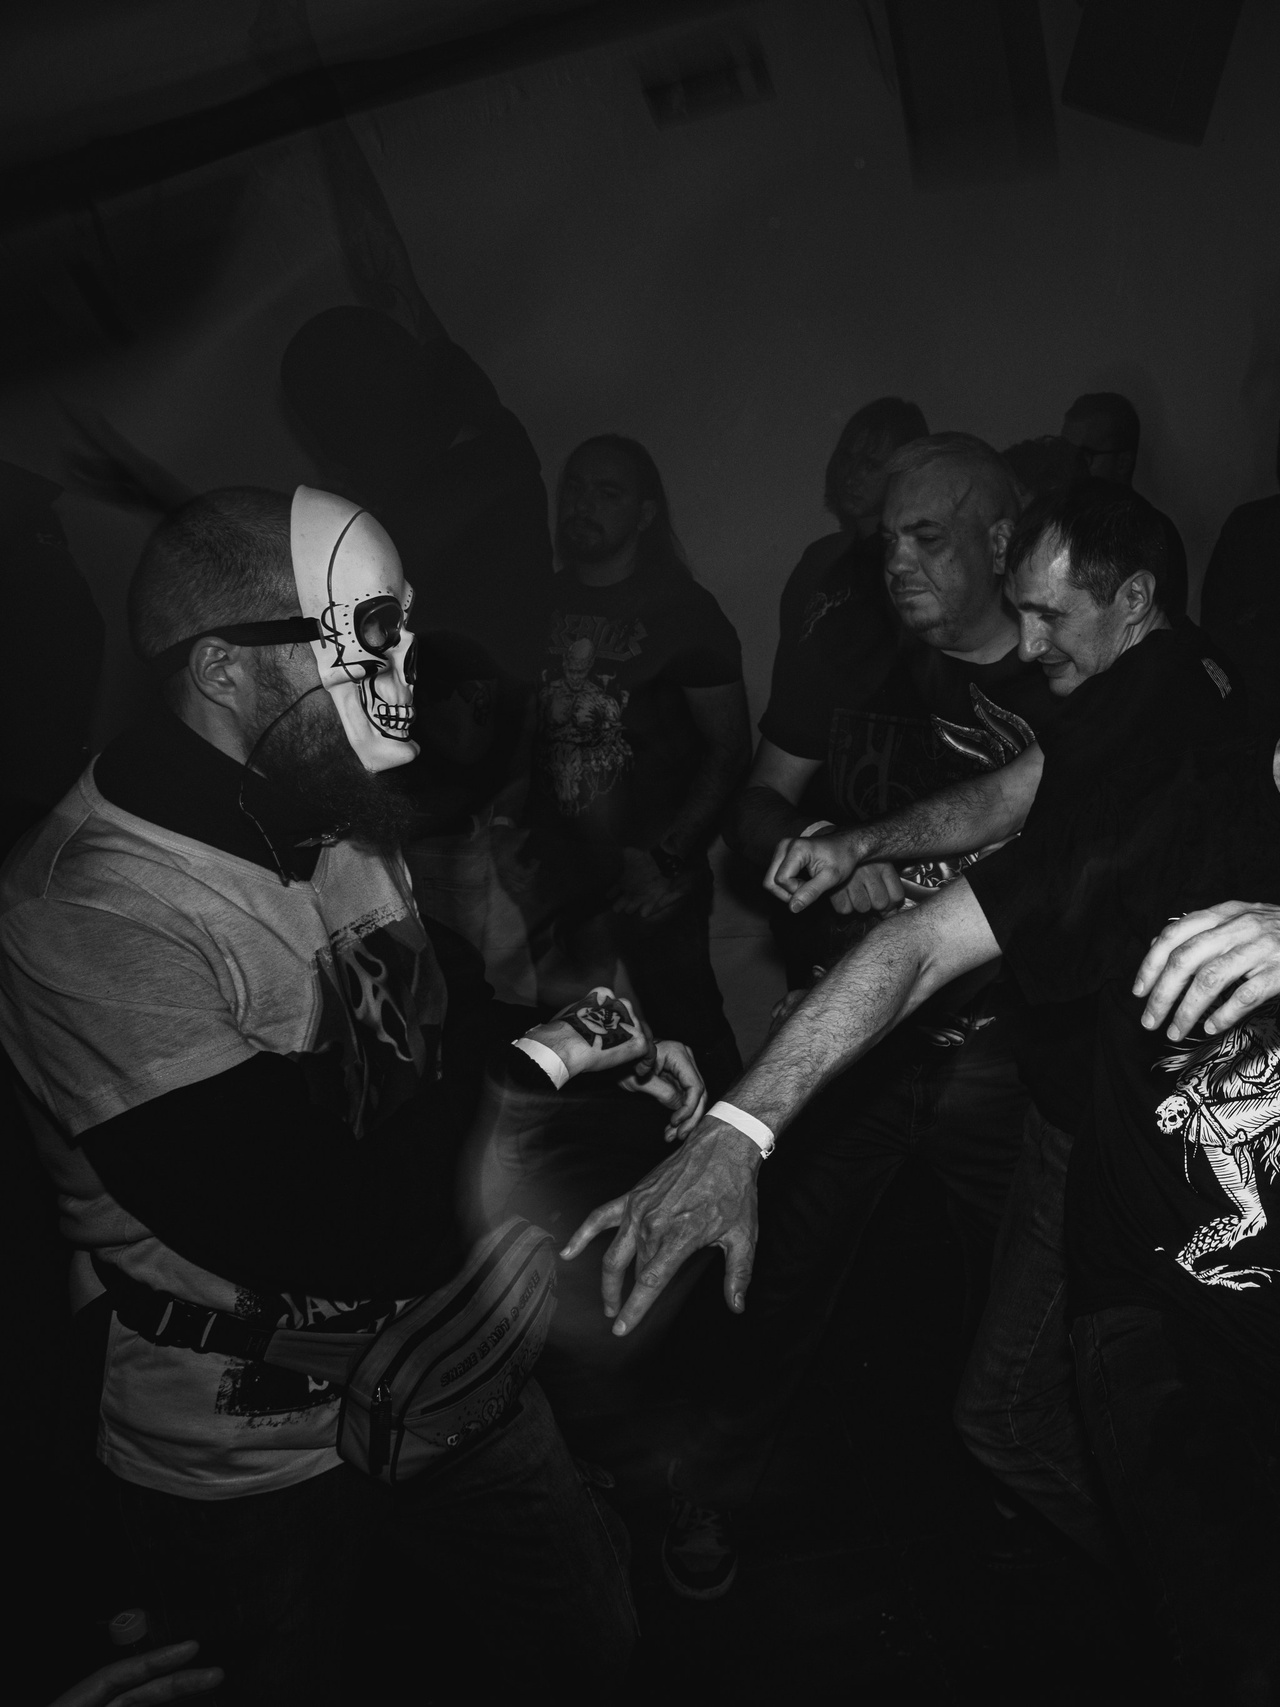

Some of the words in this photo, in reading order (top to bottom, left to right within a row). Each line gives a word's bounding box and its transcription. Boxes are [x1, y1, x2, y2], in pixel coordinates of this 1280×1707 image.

[477, 1341, 491, 1360] IS
[487, 1317, 511, 1347] NOT
[510, 1306, 520, 1322] A
